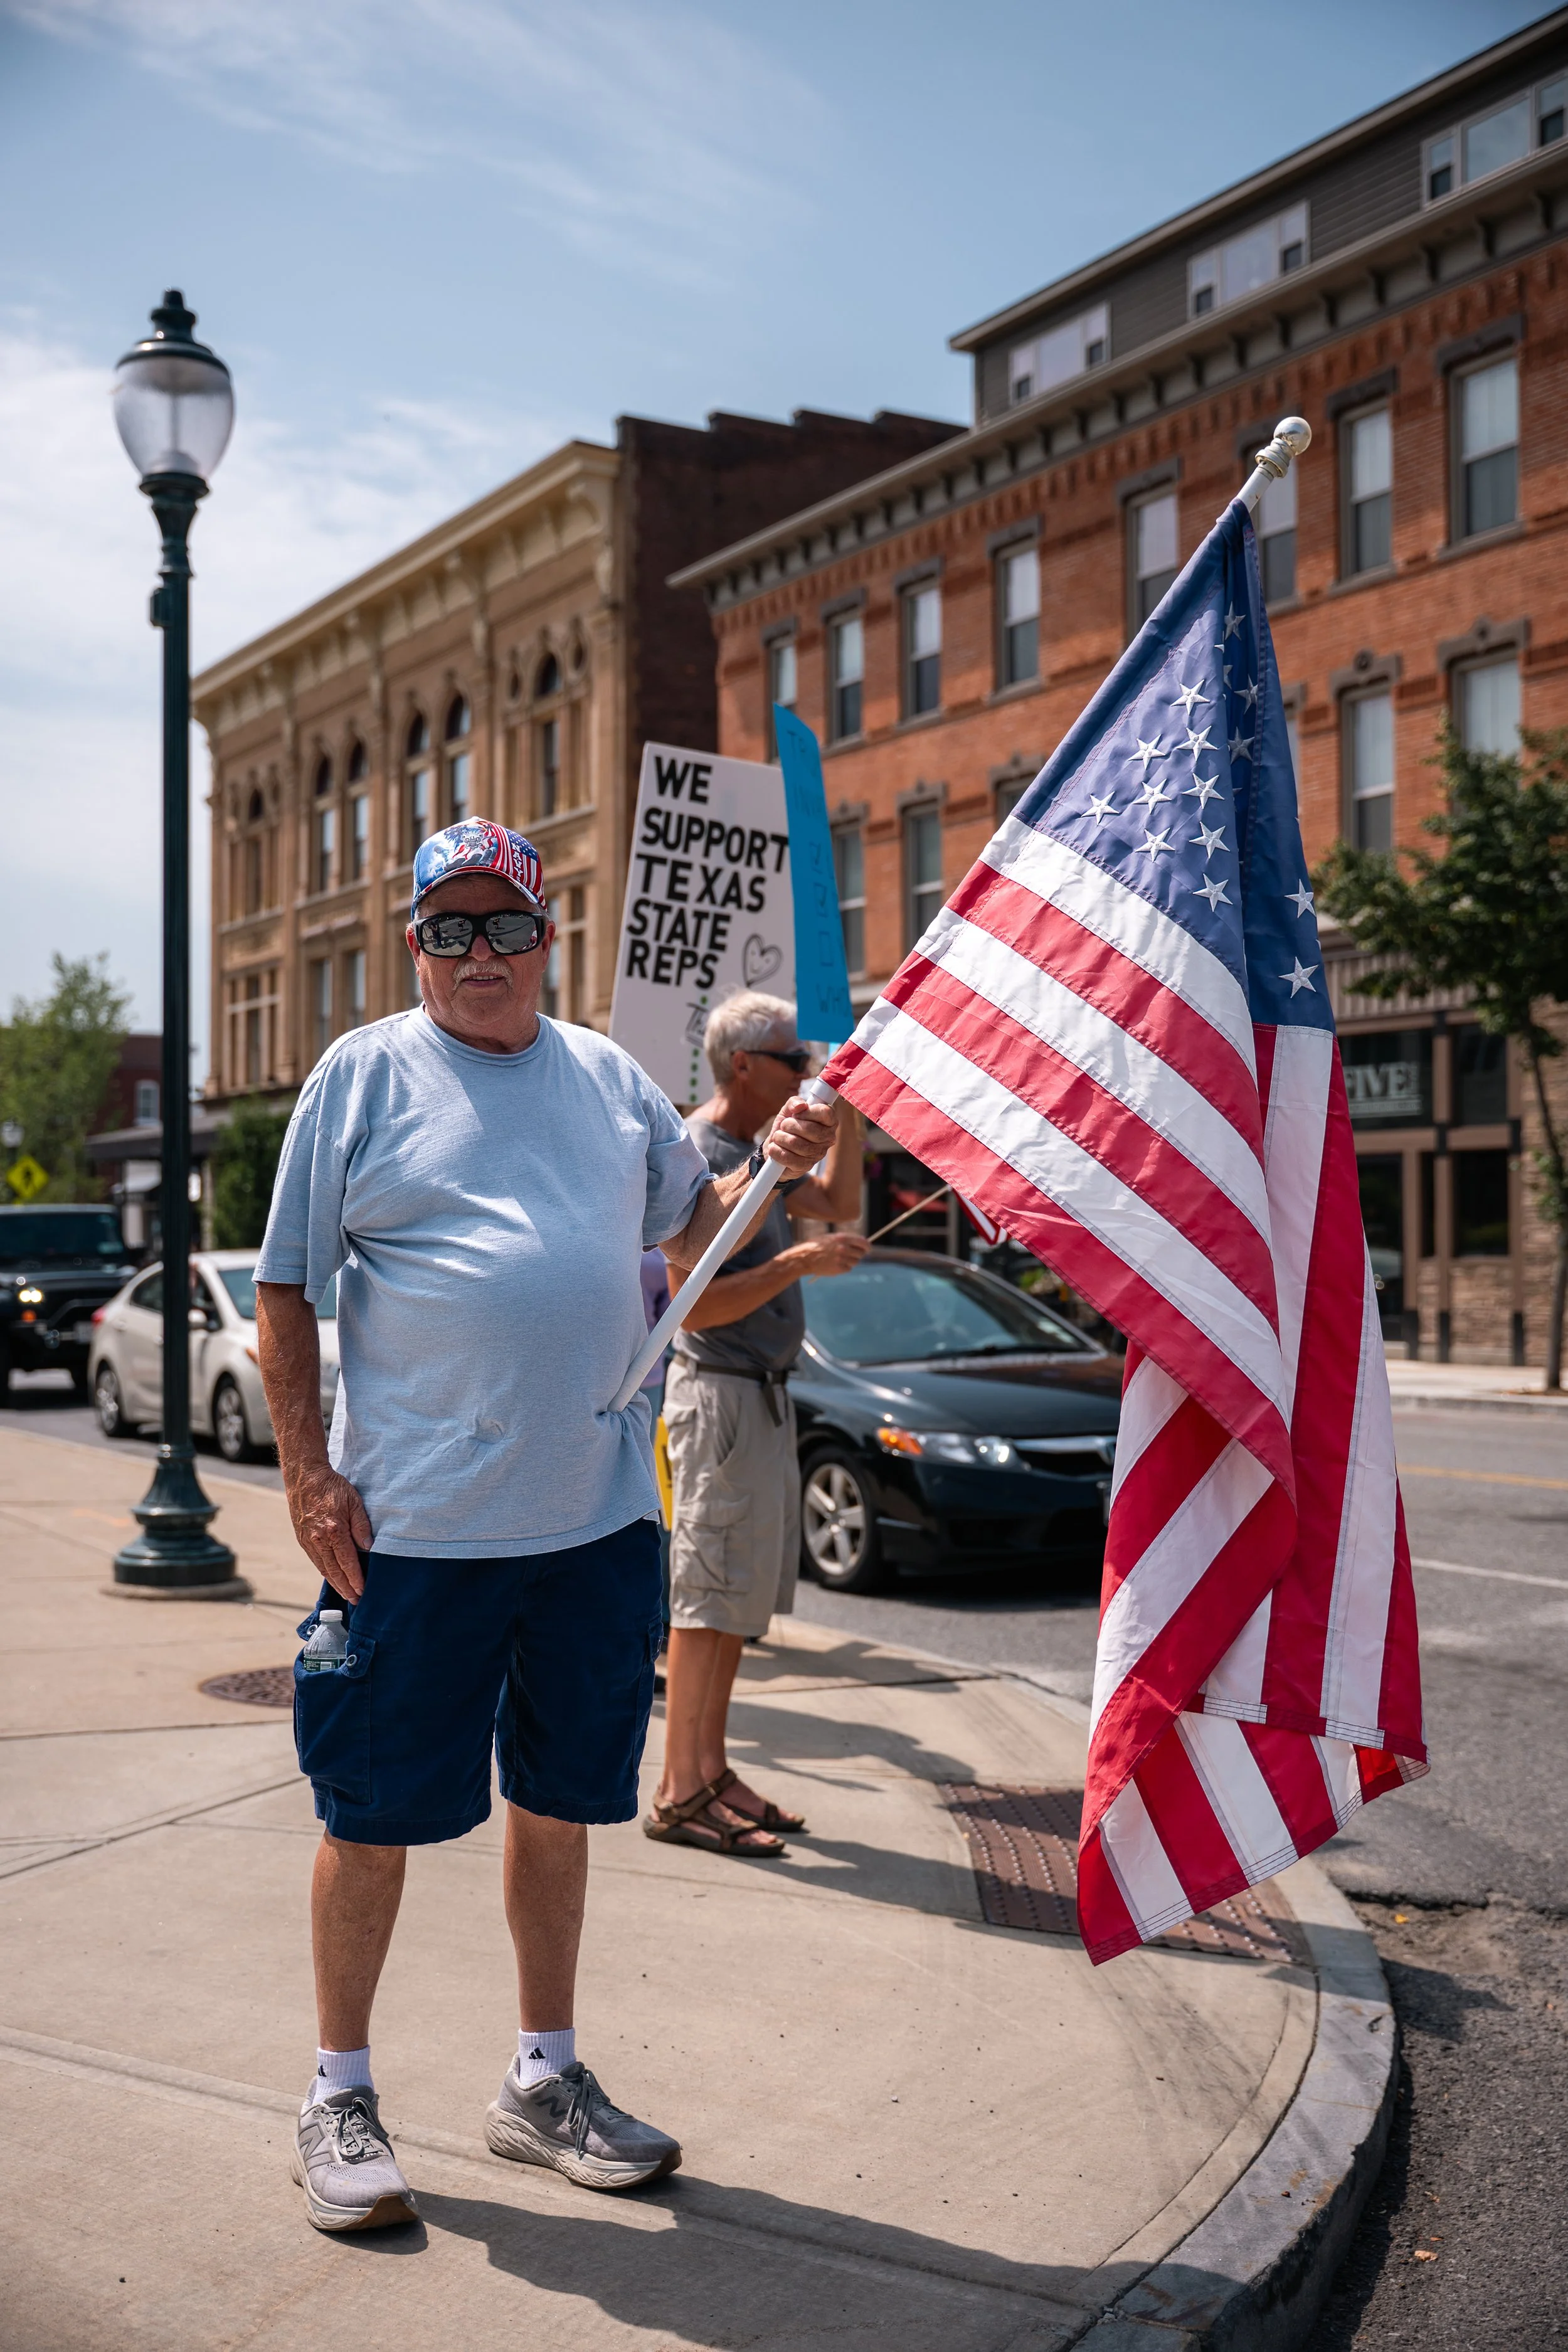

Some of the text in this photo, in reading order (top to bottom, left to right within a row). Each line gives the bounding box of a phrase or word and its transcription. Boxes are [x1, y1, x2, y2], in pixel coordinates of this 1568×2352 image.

[655, 755, 712, 805] WE
[511, 842, 524, 877] NAVY
[642, 807, 789, 872] SUPPORT
[636, 853, 766, 913] TEXAS
[627, 898, 731, 951] STATE
[627, 939, 719, 989] REPS
